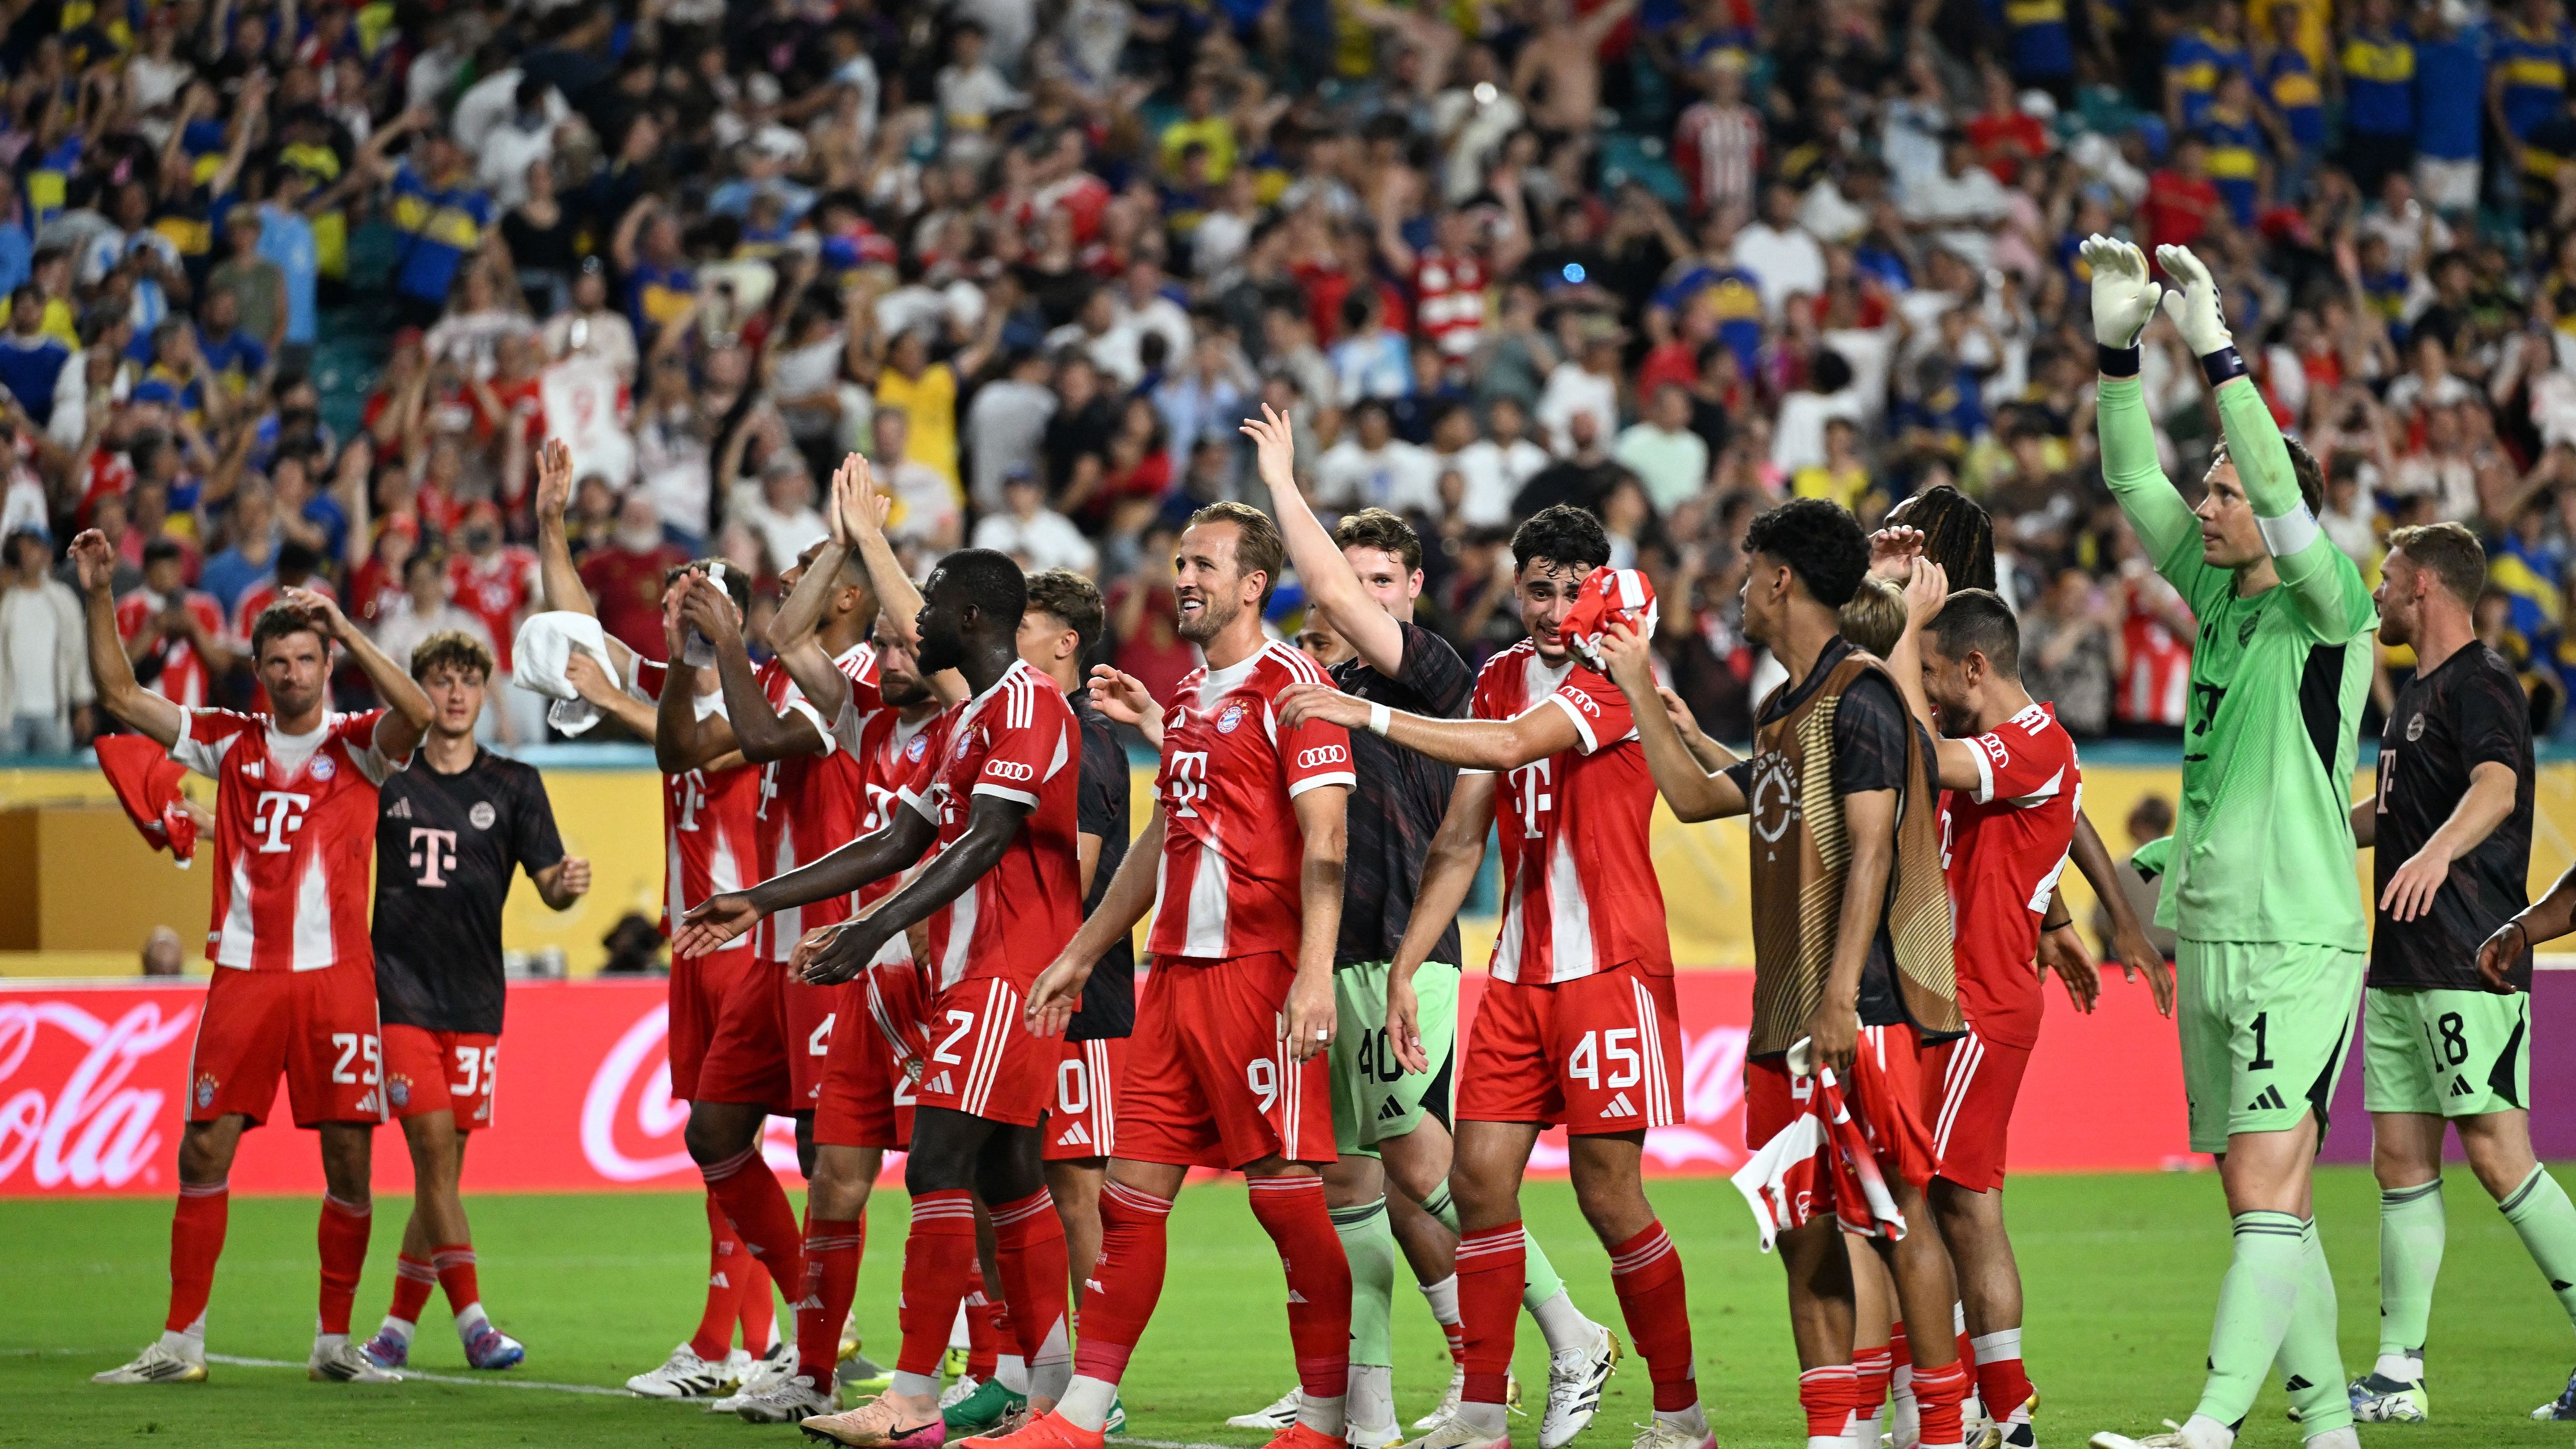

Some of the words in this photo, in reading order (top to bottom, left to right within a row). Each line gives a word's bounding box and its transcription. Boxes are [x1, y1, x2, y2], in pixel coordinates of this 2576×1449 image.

[1170, 751, 1208, 817] T
[254, 791, 311, 853] T
[410, 828, 457, 888] T
[332, 1033, 380, 1085] 25
[932, 1010, 975, 1066] 2
[1358, 1026, 1404, 1085] 40
[1569, 1027, 1640, 1090] 45
[2248, 1011, 2274, 1072] 1
[2424, 1011, 2469, 1074] 18
[450, 1046, 497, 1096] 35
[1049, 1058, 1089, 1116] 0
[1246, 1058, 1277, 1115] 9
